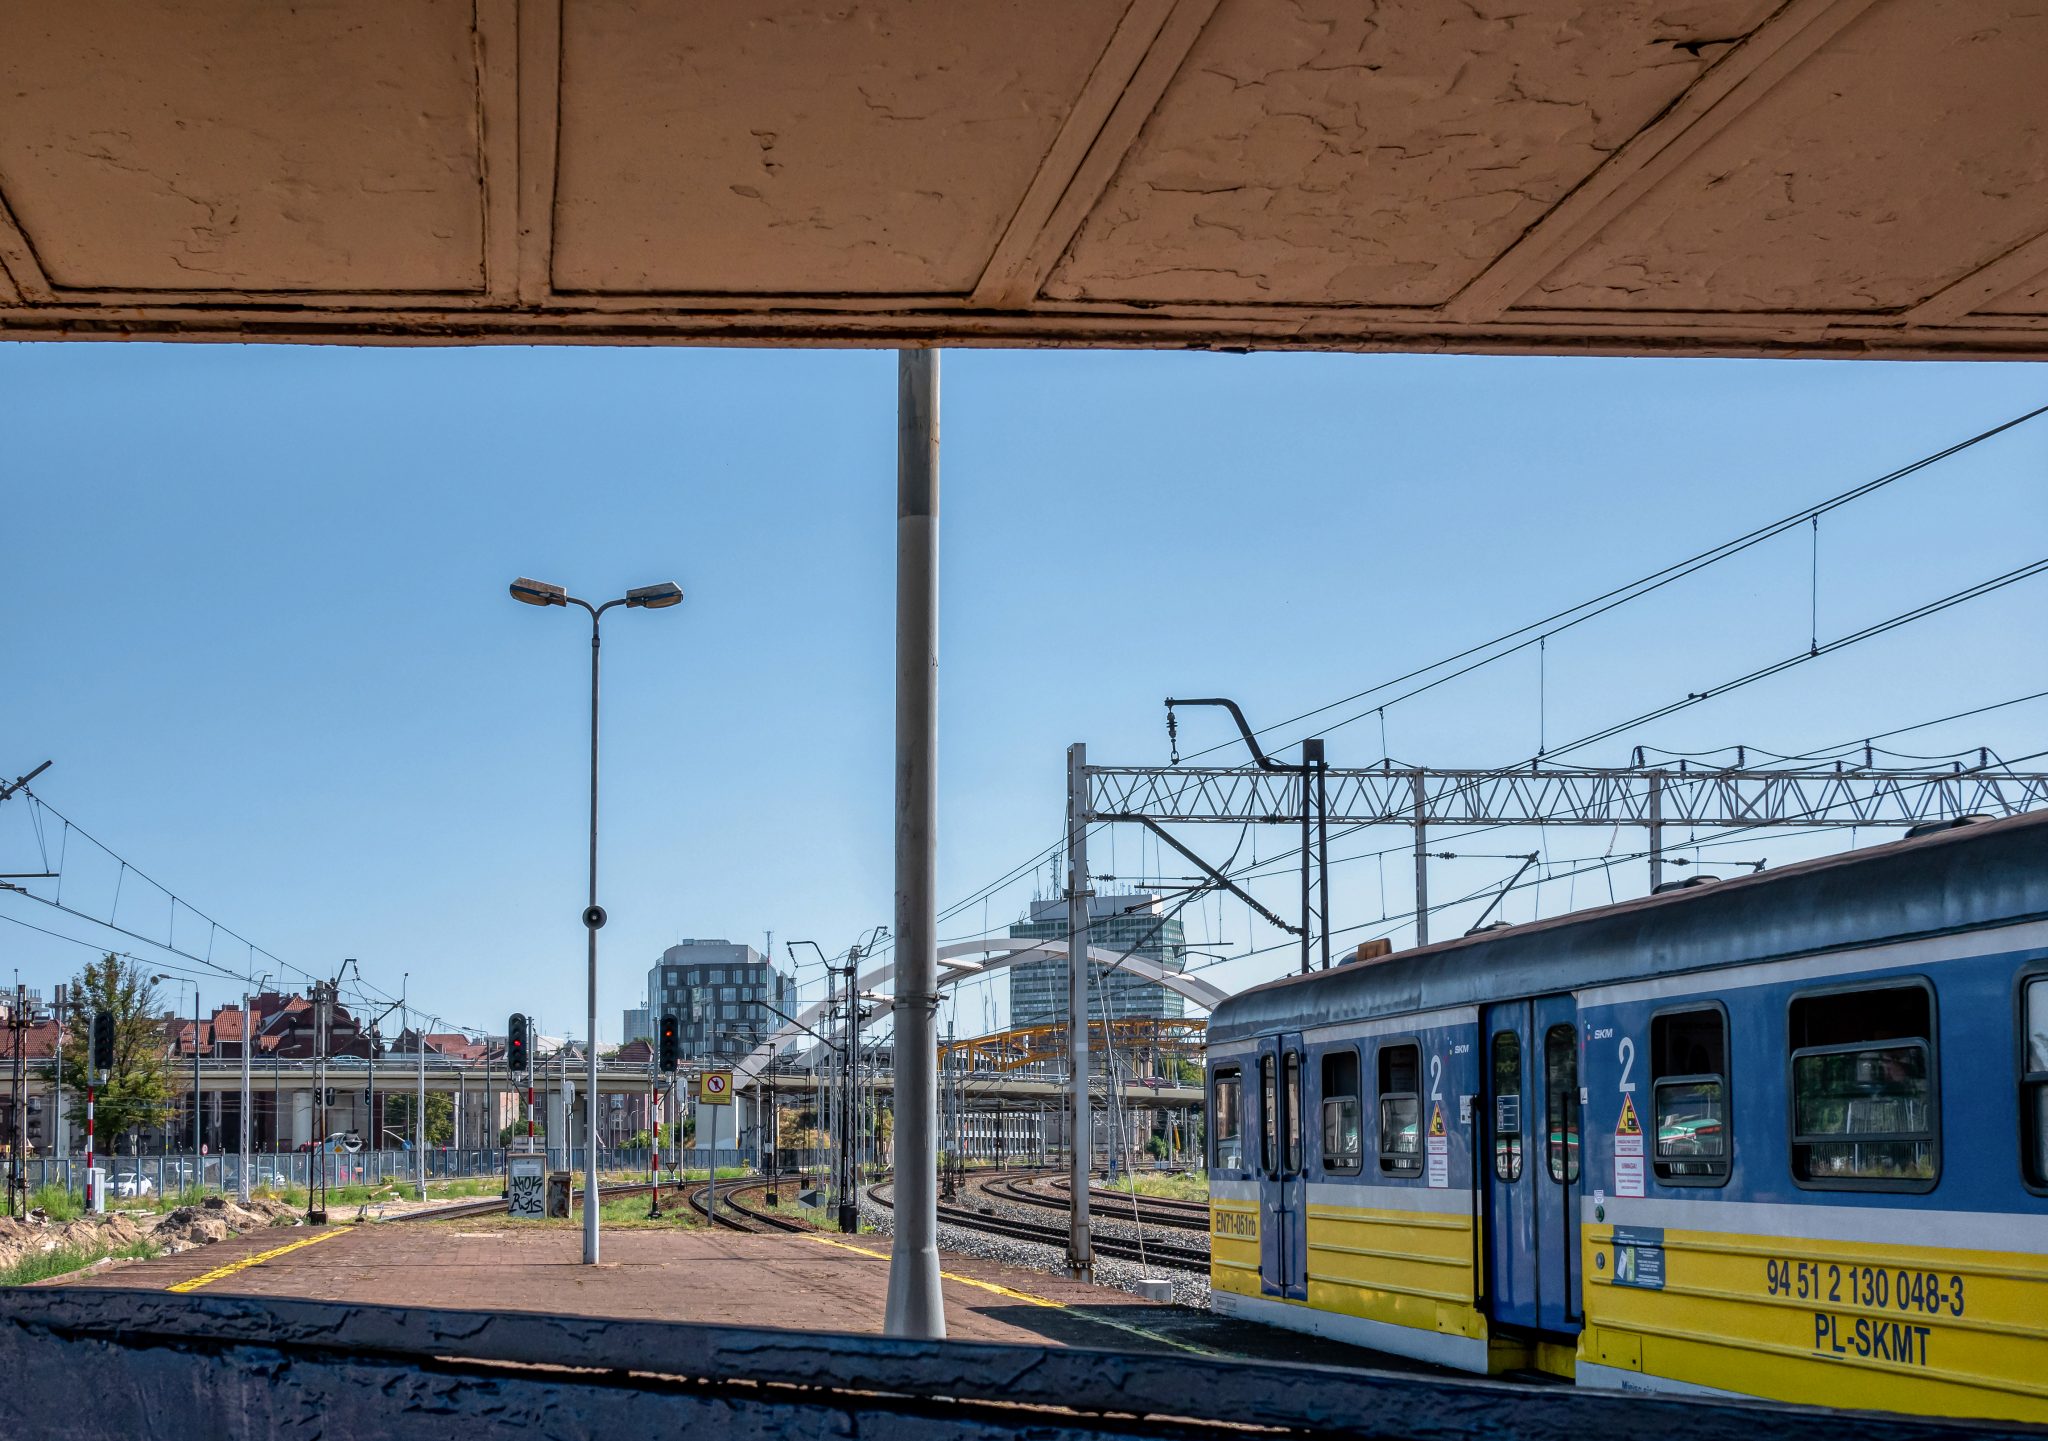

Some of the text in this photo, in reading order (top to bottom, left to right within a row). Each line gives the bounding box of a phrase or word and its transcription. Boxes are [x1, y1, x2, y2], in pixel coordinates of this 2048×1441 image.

[1454, 1044, 1469, 1054] SKM
[1594, 1028, 1613, 1039] SKM
[1430, 1054, 1443, 1101] 2
[1618, 1036, 1636, 1092] 2
[1216, 1212, 1256, 1236] EN71-051rb
[1767, 1259, 1965, 1317] 94 51 2 130 048-3
[1814, 1312, 1931, 1366] PL-SKMT
